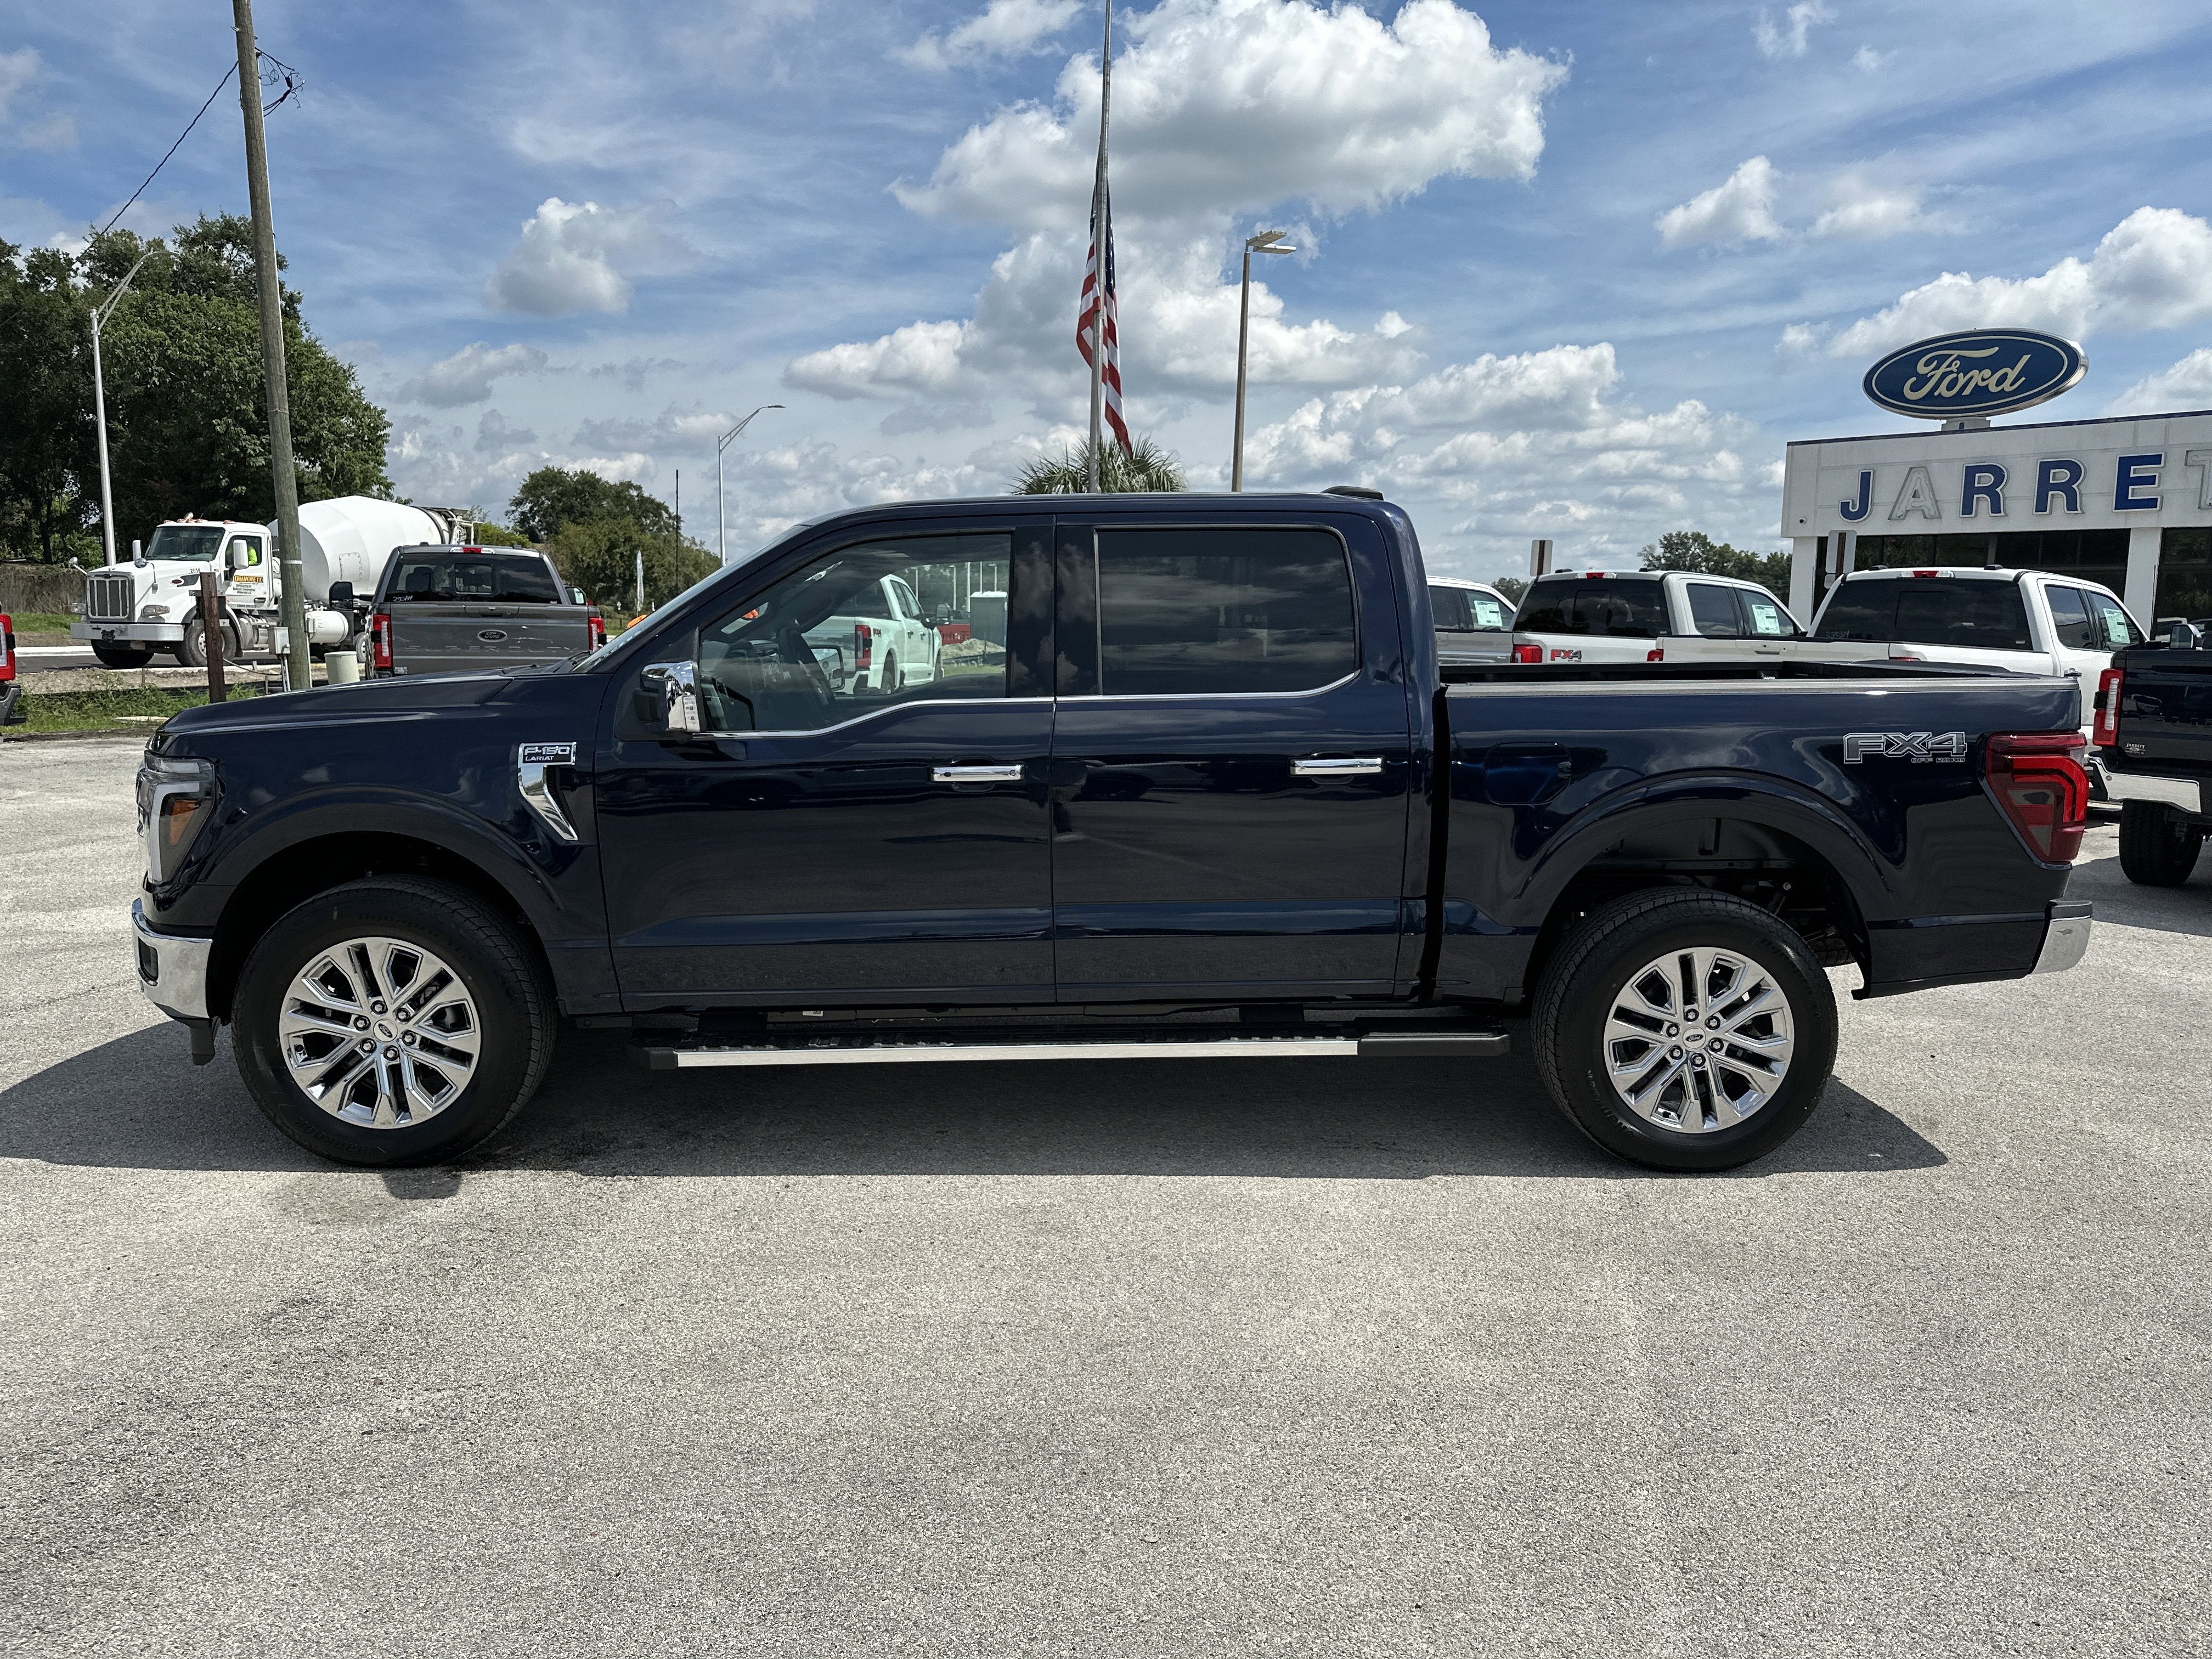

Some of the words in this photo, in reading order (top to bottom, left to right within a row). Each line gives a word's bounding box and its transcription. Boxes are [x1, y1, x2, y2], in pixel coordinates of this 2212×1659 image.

[1903, 347, 2031, 400] Ford
[1550, 648, 1582, 661] FX4
[524, 746, 570, 755] F-150
[1843, 731, 1967, 764] FX4
